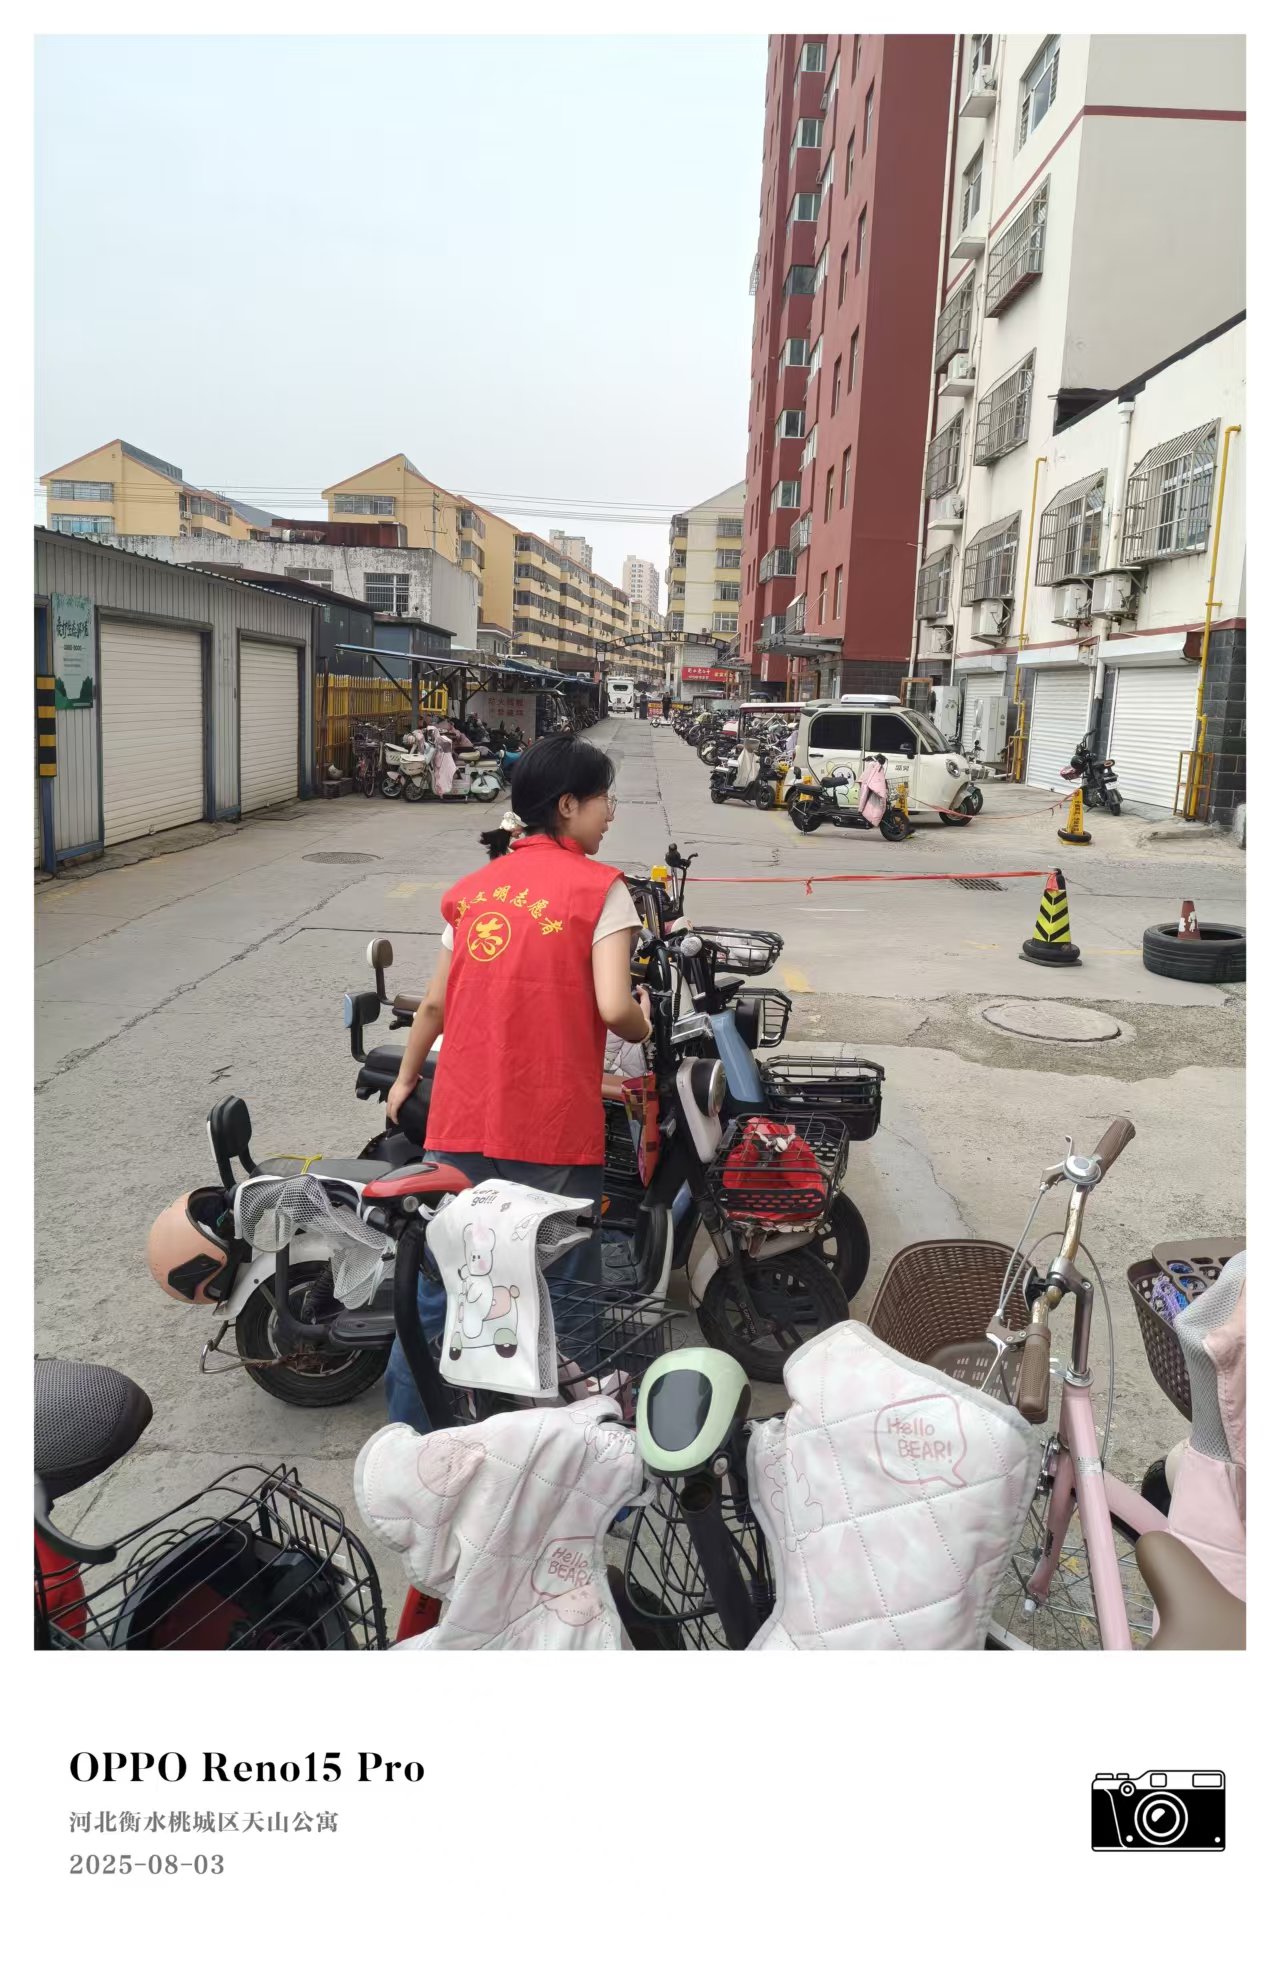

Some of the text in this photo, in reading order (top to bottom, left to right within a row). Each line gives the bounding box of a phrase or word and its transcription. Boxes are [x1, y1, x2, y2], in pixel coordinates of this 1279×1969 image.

[887, 1417, 935, 1437] Hello
[897, 1438, 953, 1463] BEAR!
[551, 1547, 589, 1569] Hello
